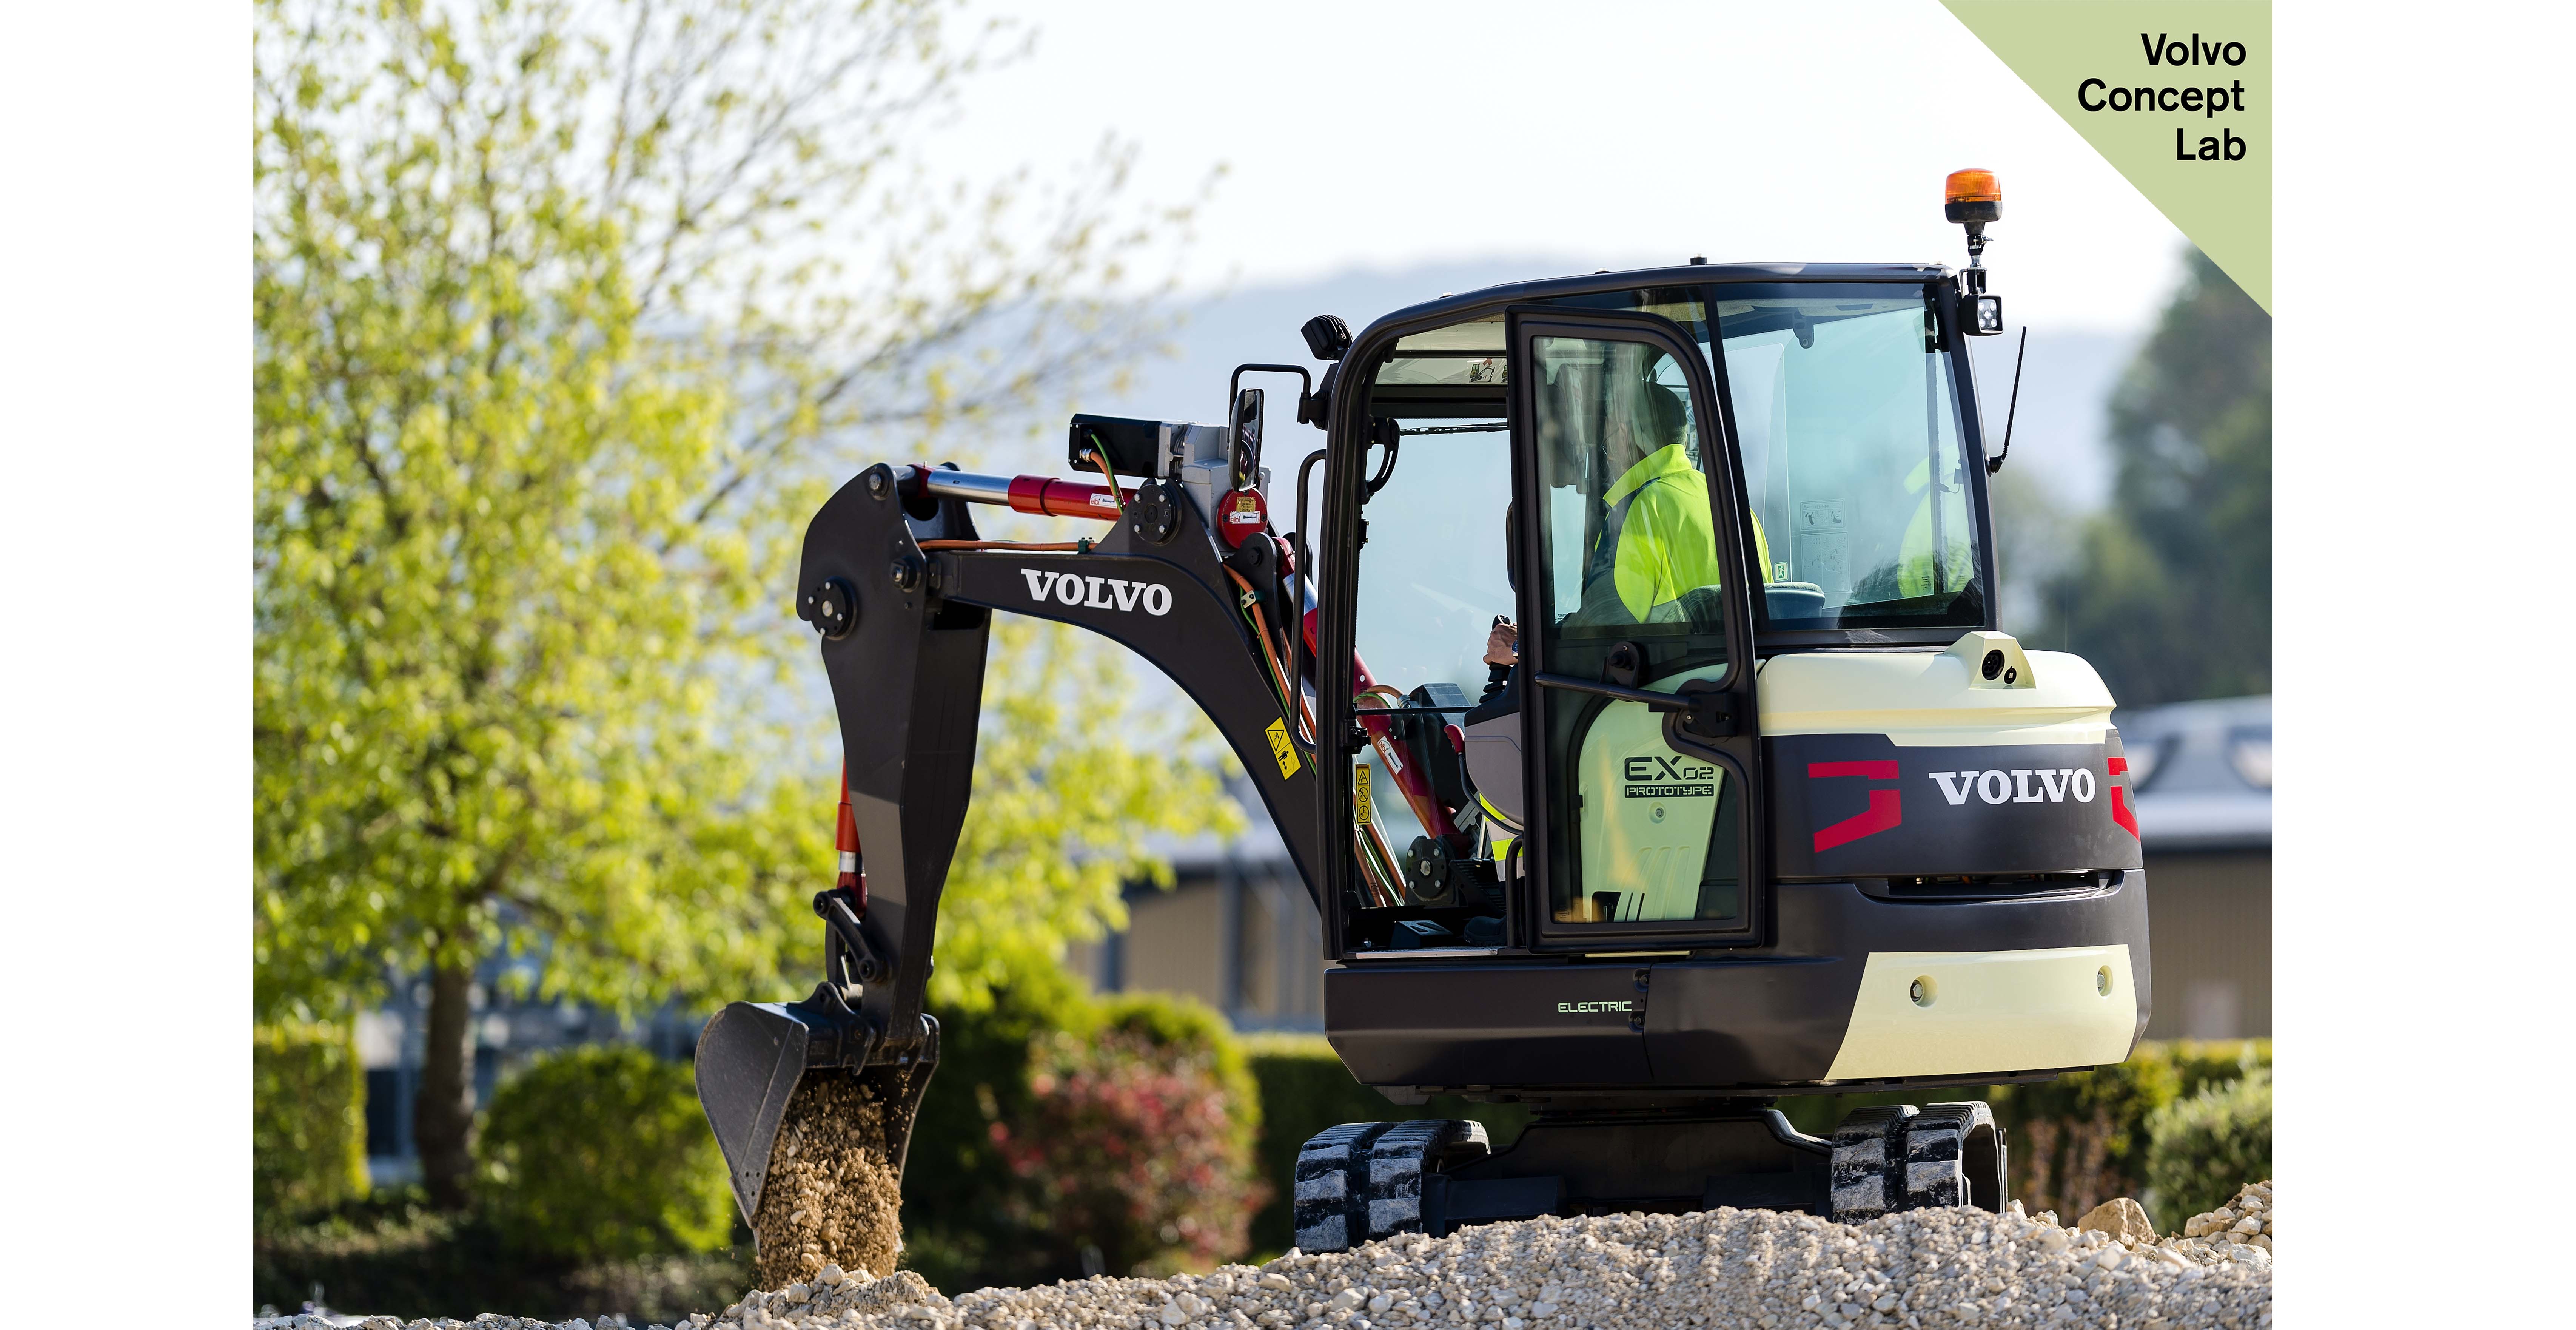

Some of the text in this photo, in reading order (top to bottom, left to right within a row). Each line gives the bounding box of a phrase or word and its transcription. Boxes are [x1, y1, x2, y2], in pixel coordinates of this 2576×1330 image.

[1021, 568, 1172, 616] VOLVO
[1626, 785, 1712, 796] PROTOTYPE
[1929, 768, 2096, 805] VOLVO
[1558, 1001, 1632, 1013] ELECTRIC
